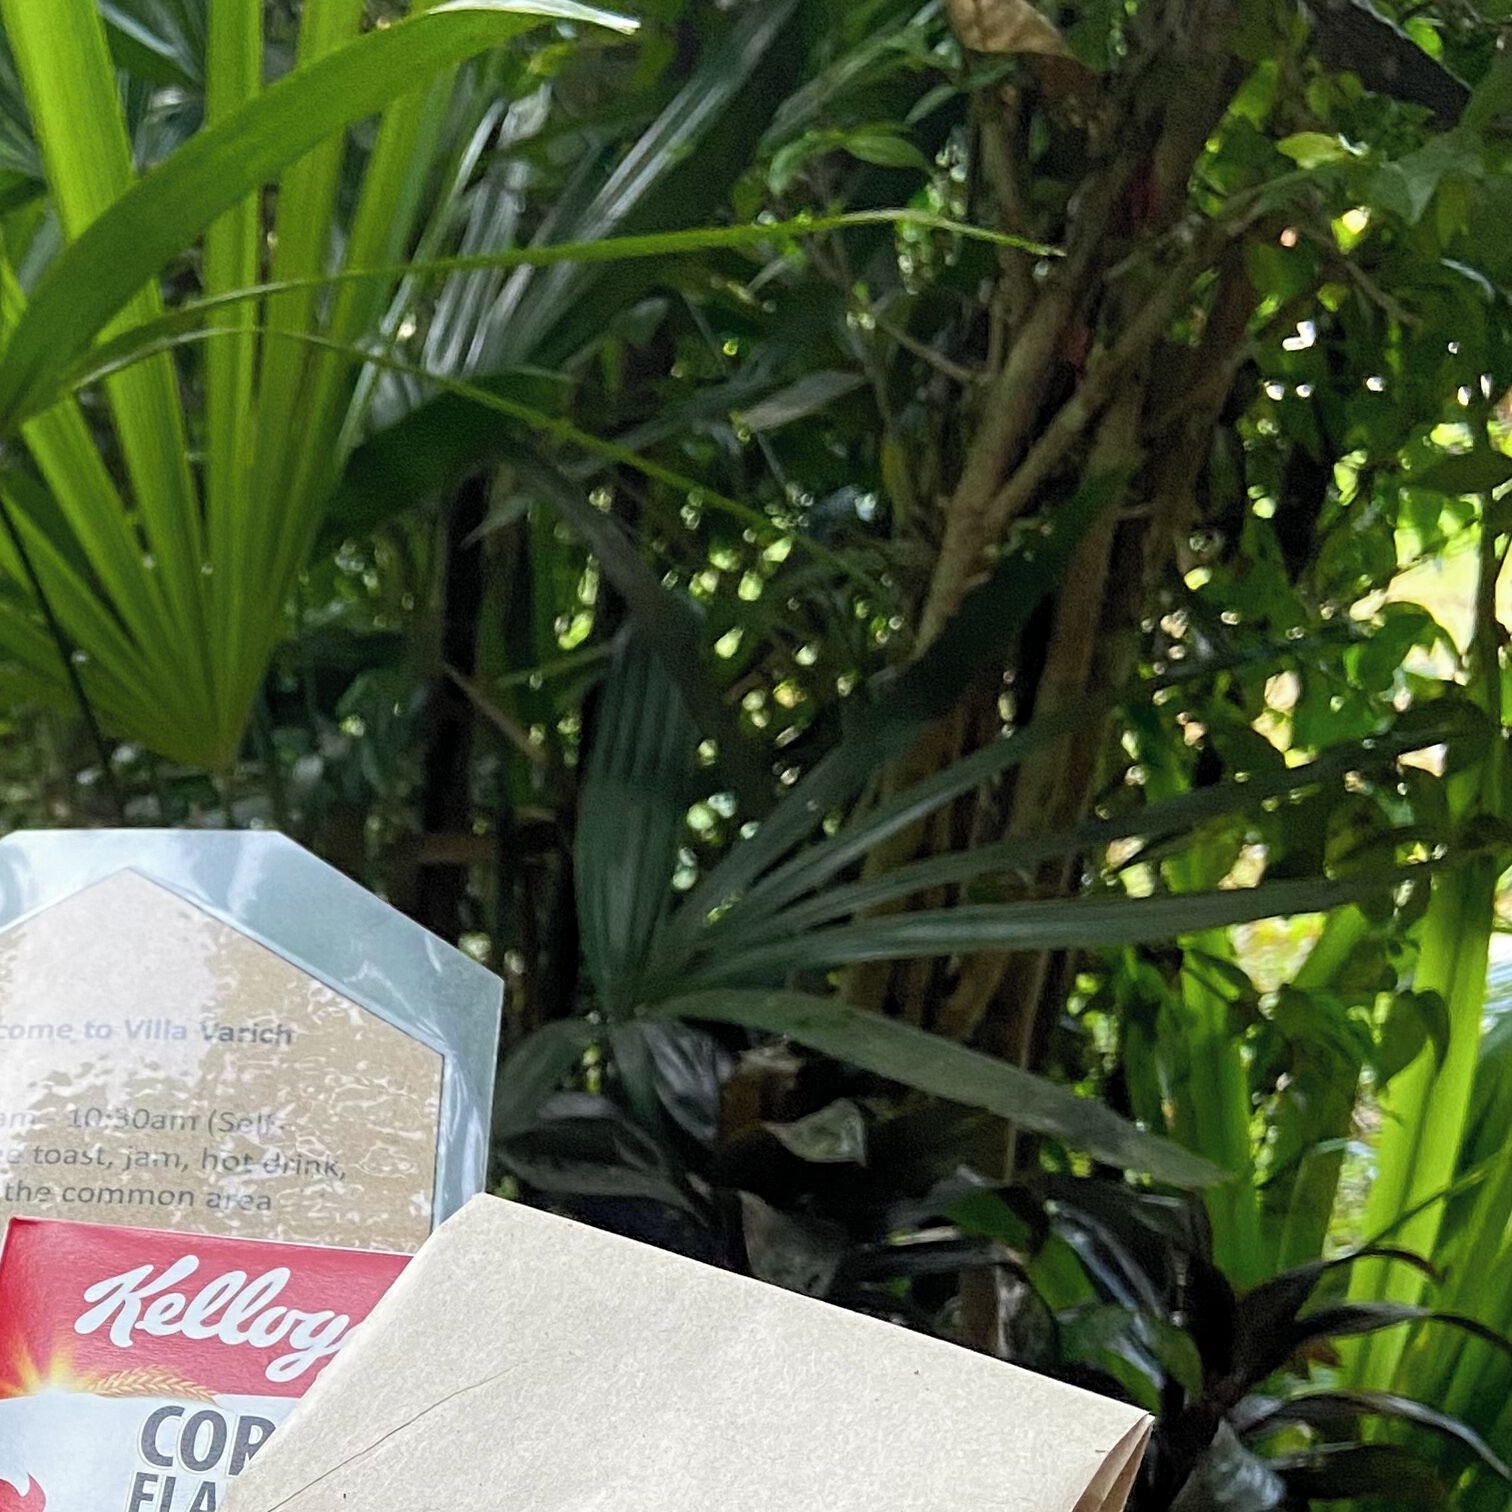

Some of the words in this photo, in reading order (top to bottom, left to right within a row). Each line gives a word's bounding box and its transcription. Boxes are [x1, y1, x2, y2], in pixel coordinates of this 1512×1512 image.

[84, 1022, 112, 1040] to
[125, 1019, 187, 1041] Villa
[200, 1020, 293, 1045] Varich
[33, 1145, 114, 1169] toast,
[123, 1145, 188, 1173] jam,
[201, 1147, 254, 1172] hot
[5, 1180, 50, 1202] the
[62, 1185, 194, 1207] common
[205, 1190, 273, 1212] area
[73, 1254, 350, 1383] Kellog
[140, 1404, 277, 1477] COR
